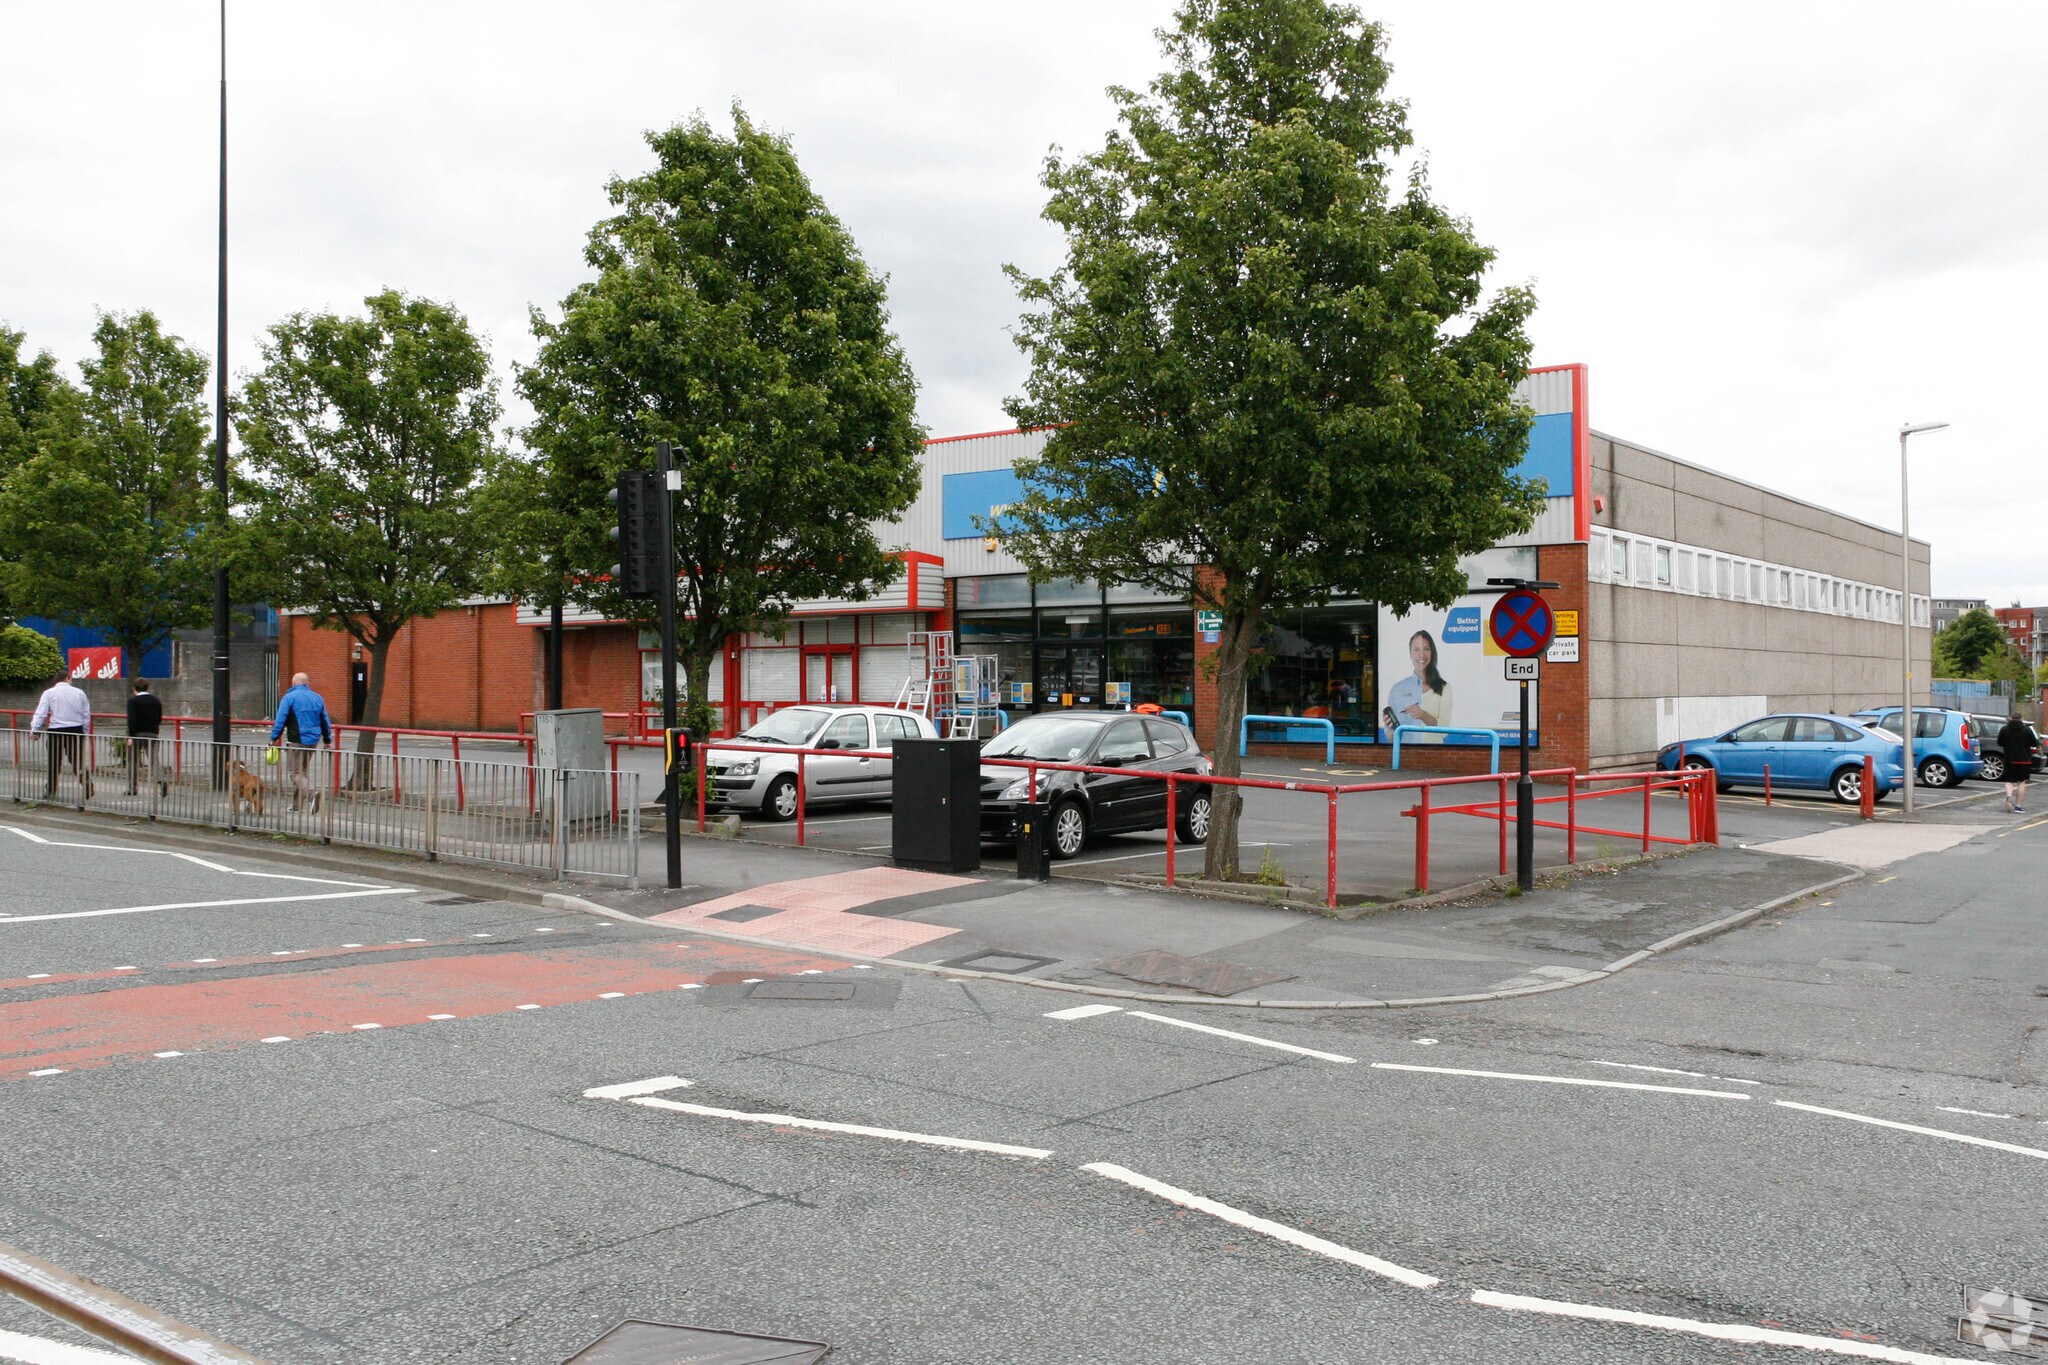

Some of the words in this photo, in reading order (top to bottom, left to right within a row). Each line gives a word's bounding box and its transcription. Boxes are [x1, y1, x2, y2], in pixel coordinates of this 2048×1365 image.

[1561, 649, 1577, 657] park
[72, 656, 90, 678] SALE
[97, 656, 118, 678] SALE
[1511, 663, 1534, 674] End
